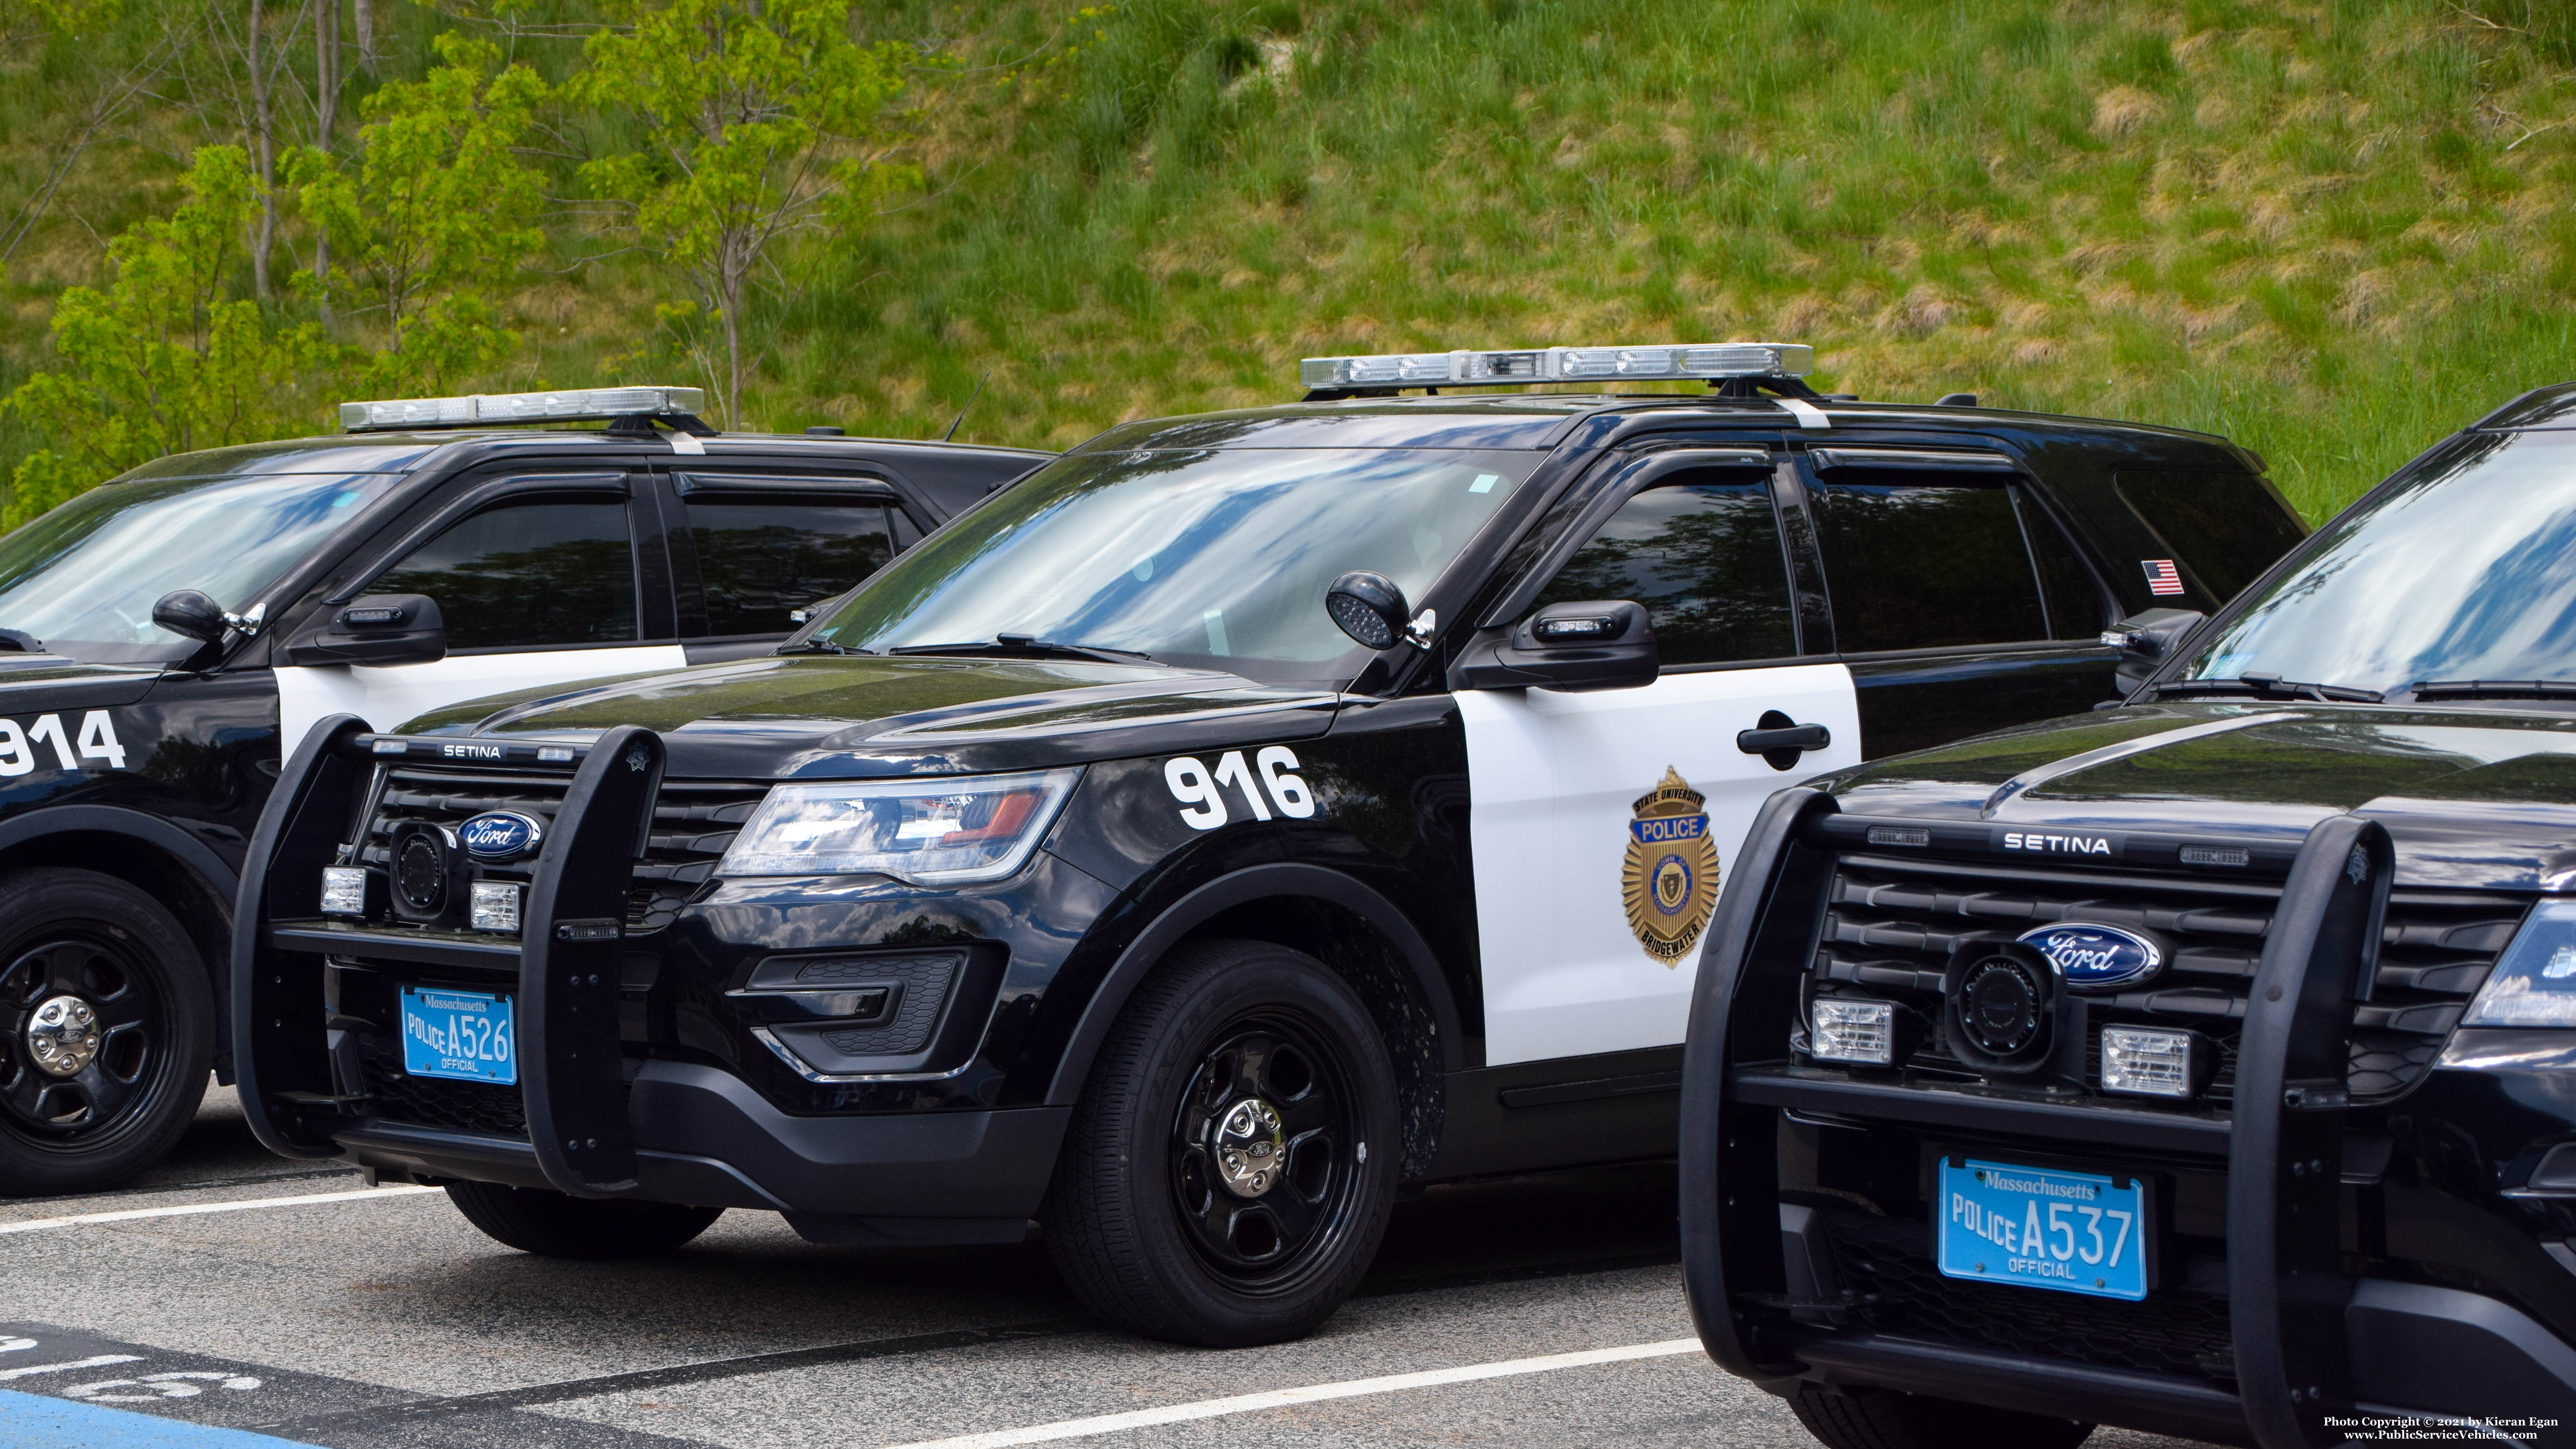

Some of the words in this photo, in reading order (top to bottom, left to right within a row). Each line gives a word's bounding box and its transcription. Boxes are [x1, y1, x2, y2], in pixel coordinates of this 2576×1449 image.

[0, 710, 126, 777] 914
[444, 745, 501, 759] SETINA
[1164, 746, 1315, 830] 916
[1635, 790, 1658, 812] STATE
[1661, 788, 1704, 805] UNIVERSITY
[467, 818, 515, 846] Ford
[1642, 818, 1699, 841] POLICE
[2004, 833, 2110, 854] SETINA
[1658, 856, 1677, 870] COMM.
[1653, 890, 1690, 914] MASSACHUSETTS
[1641, 924, 1699, 956] BRIDGEWATER
[2041, 931, 2120, 970] Ford
[425, 995, 486, 1012] Massachusetts
[408, 1012, 446, 1055] POLICE
[448, 1014, 508, 1063] A526
[442, 1059, 478, 1073] OFFICIAL
[1985, 1170, 2095, 1201] Massachusetts
[1952, 1192, 2017, 1254] POLICE
[2021, 1199, 2132, 1268] A537
[2008, 1257, 2076, 1280] OFFICIAL
